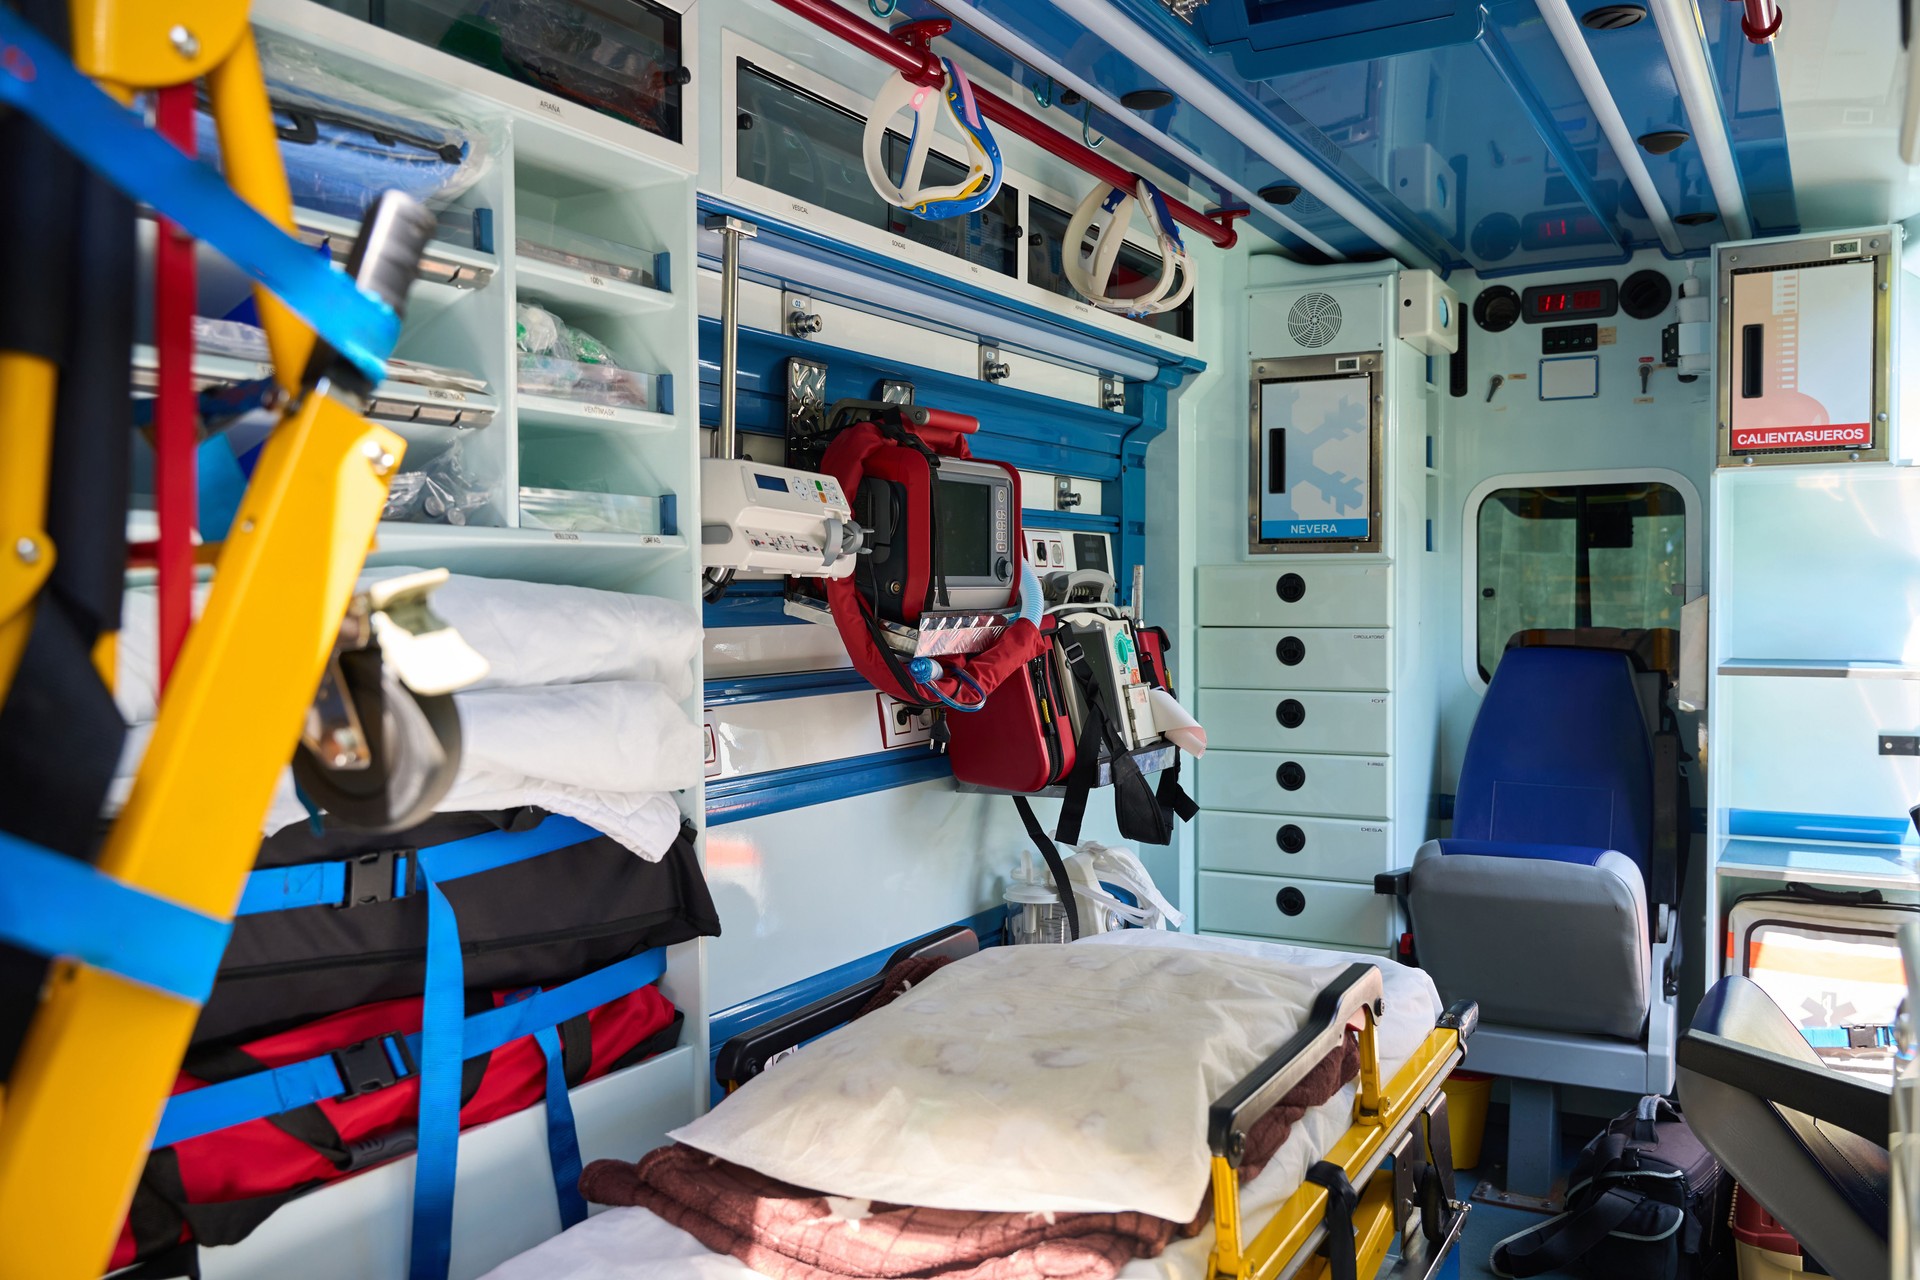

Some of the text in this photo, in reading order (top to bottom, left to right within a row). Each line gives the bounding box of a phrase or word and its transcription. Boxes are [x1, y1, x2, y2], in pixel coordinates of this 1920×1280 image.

[540, 100, 561, 113] ARAÑA
[792, 203, 808, 215] VESICAL
[583, 405, 616, 417] VENTIMASK
[1737, 428, 1864, 445] CALIENTASUEROS
[1290, 523, 1338, 534] NEVERA
